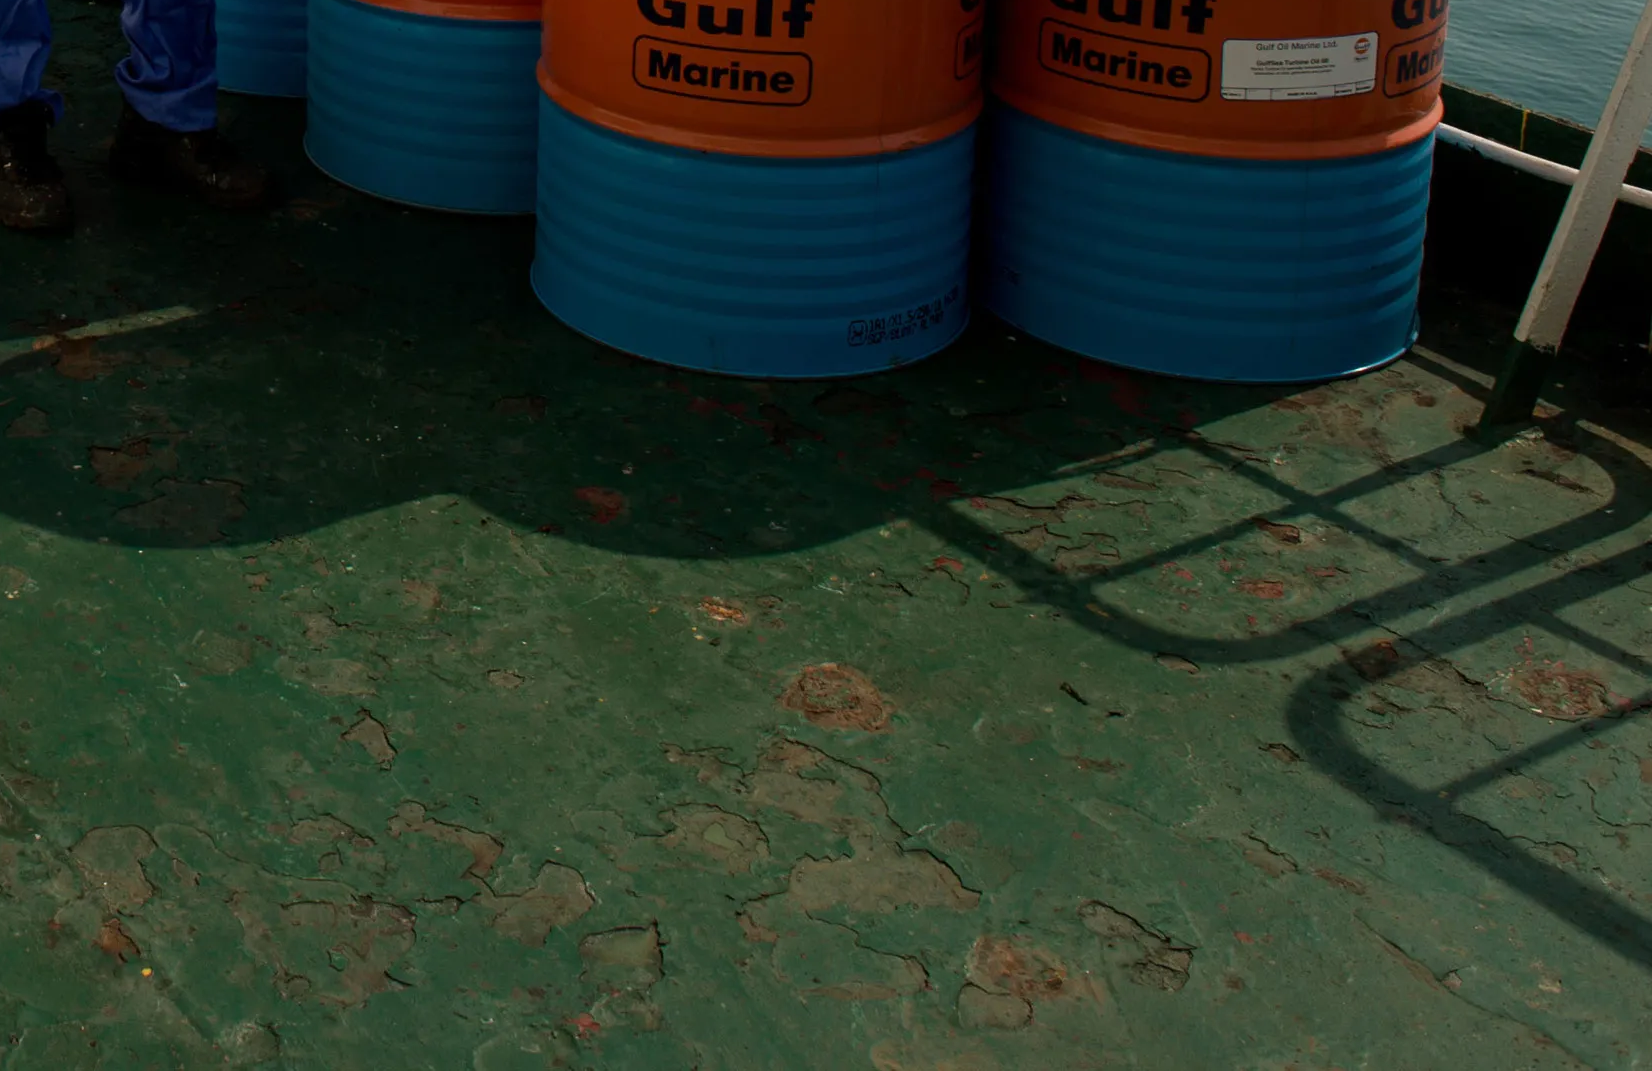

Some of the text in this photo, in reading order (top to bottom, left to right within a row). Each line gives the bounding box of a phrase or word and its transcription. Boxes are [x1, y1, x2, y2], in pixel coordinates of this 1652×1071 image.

[1052, 32, 1193, 88] Marine
[1256, 43, 1275, 51] Gulf
[1277, 42, 1289, 51] Oil
[1291, 42, 1321, 50] Marine
[649, 49, 795, 94] Marine
